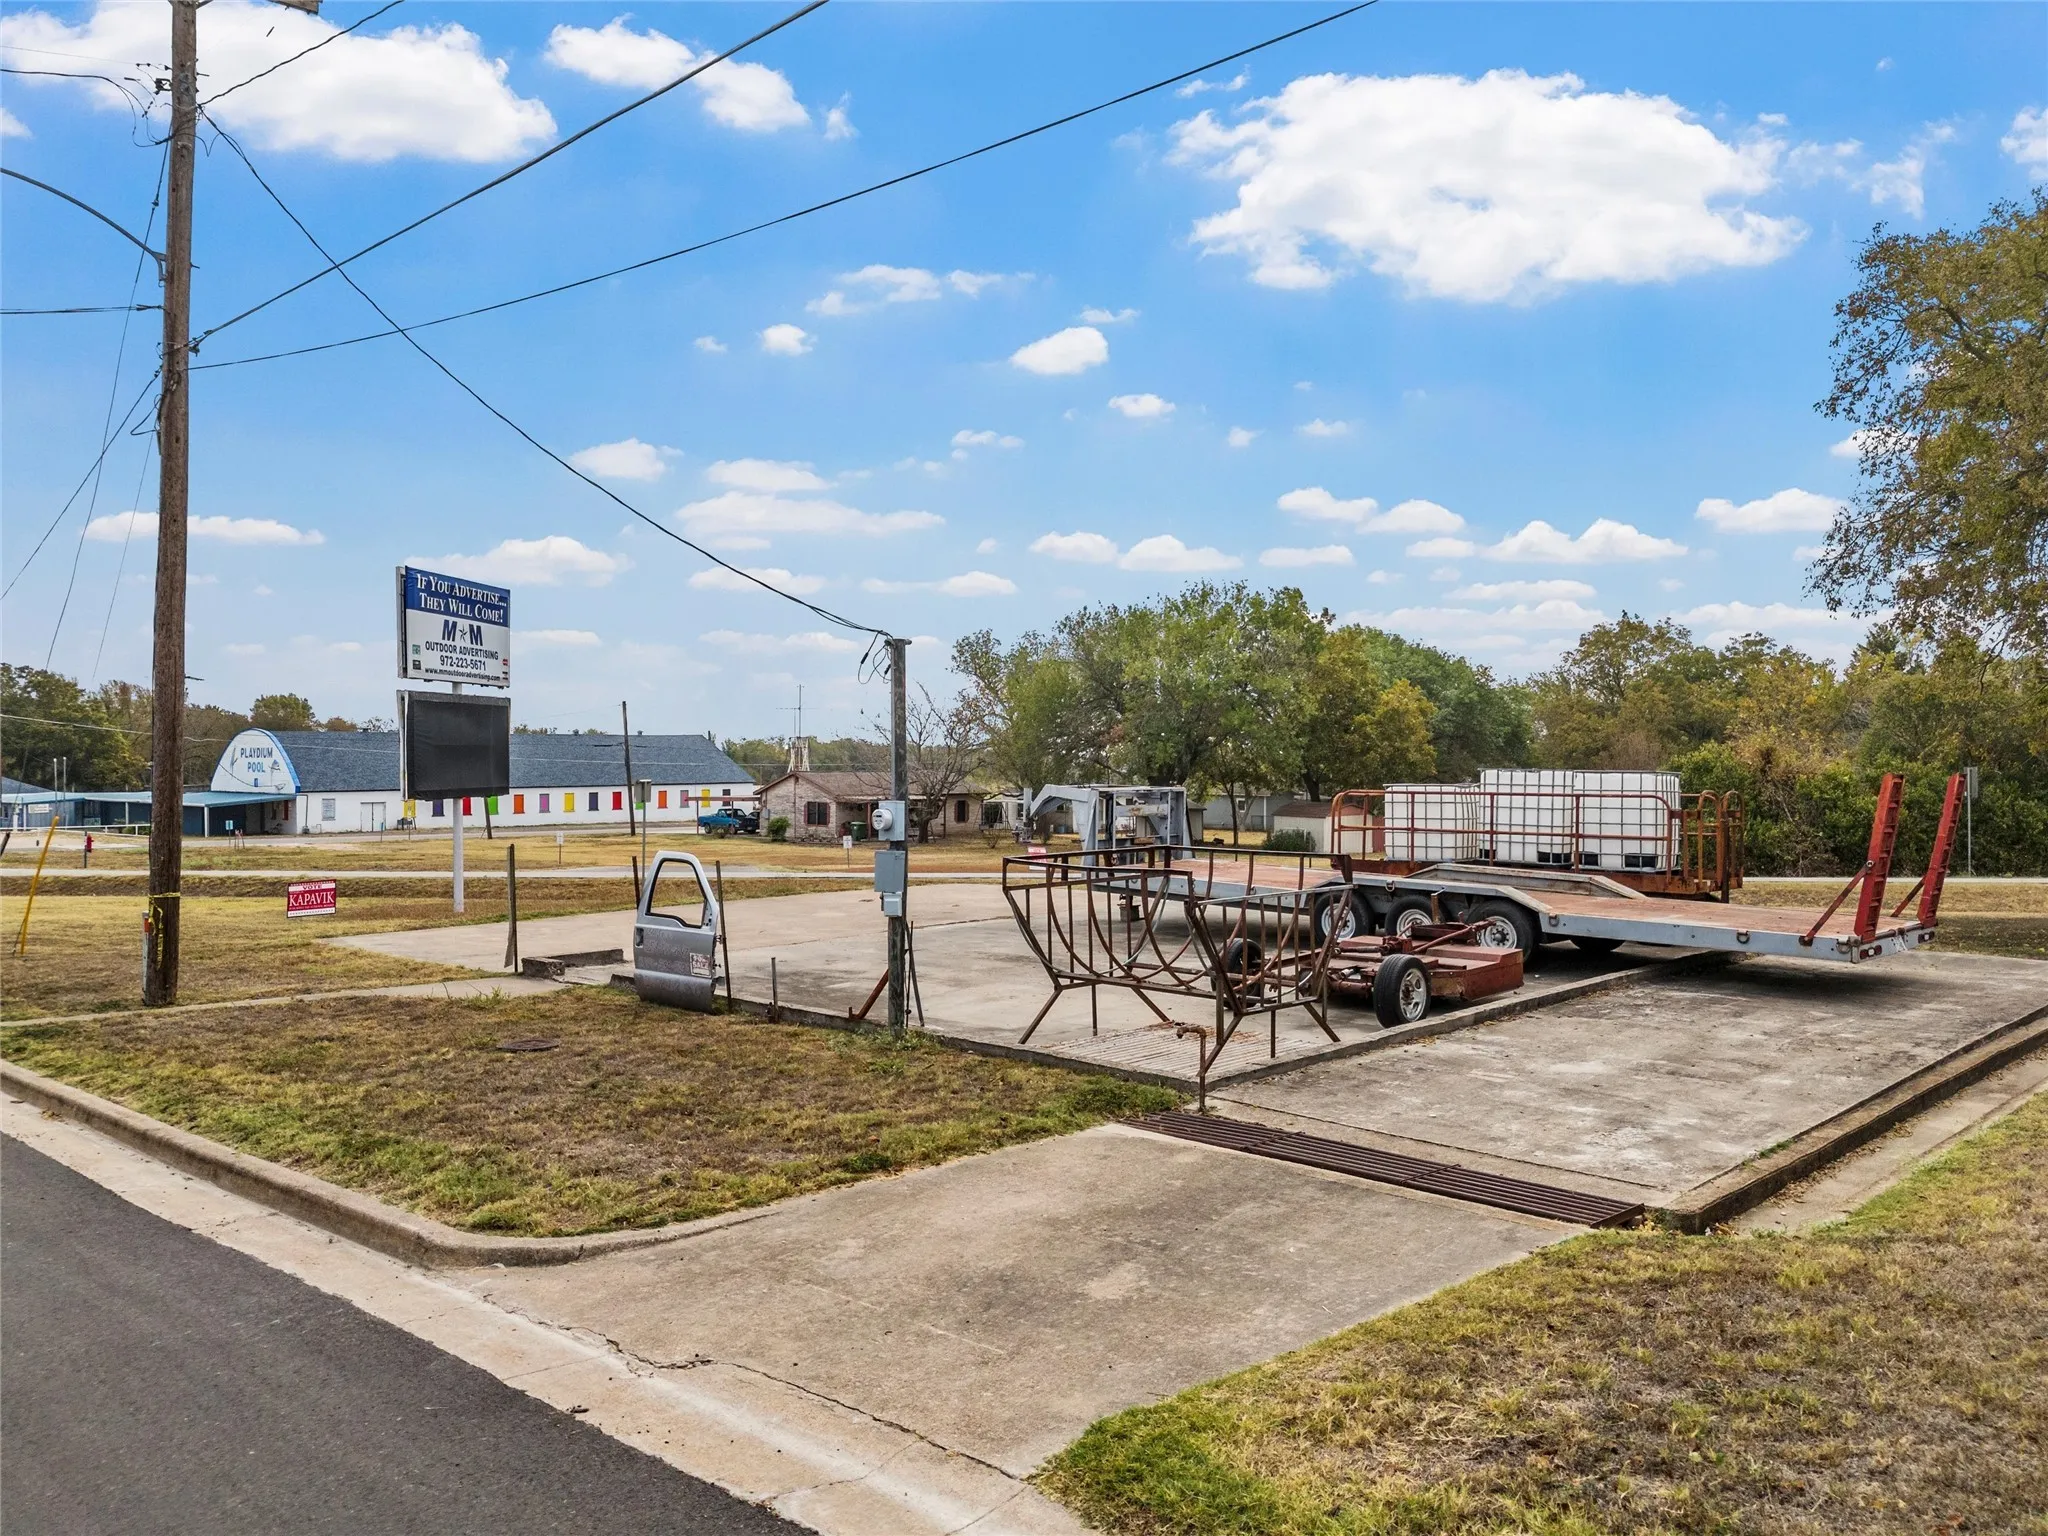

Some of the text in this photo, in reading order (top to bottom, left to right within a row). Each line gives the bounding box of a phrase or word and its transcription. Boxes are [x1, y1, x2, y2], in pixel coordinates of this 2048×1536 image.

[429, 575, 451, 594] YOU
[419, 592, 503, 623] THEY WILL COME!
[425, 640, 499, 660] OUTDOOR ADVERTISING
[439, 654, 486, 671] 972-223-5671
[424, 667, 501, 681] www.mmoutdooradvertising.com
[240, 747, 273, 759] PLAYDIUM
[247, 761, 266, 773] POOL
[289, 891, 335, 907] KAPAVIK
